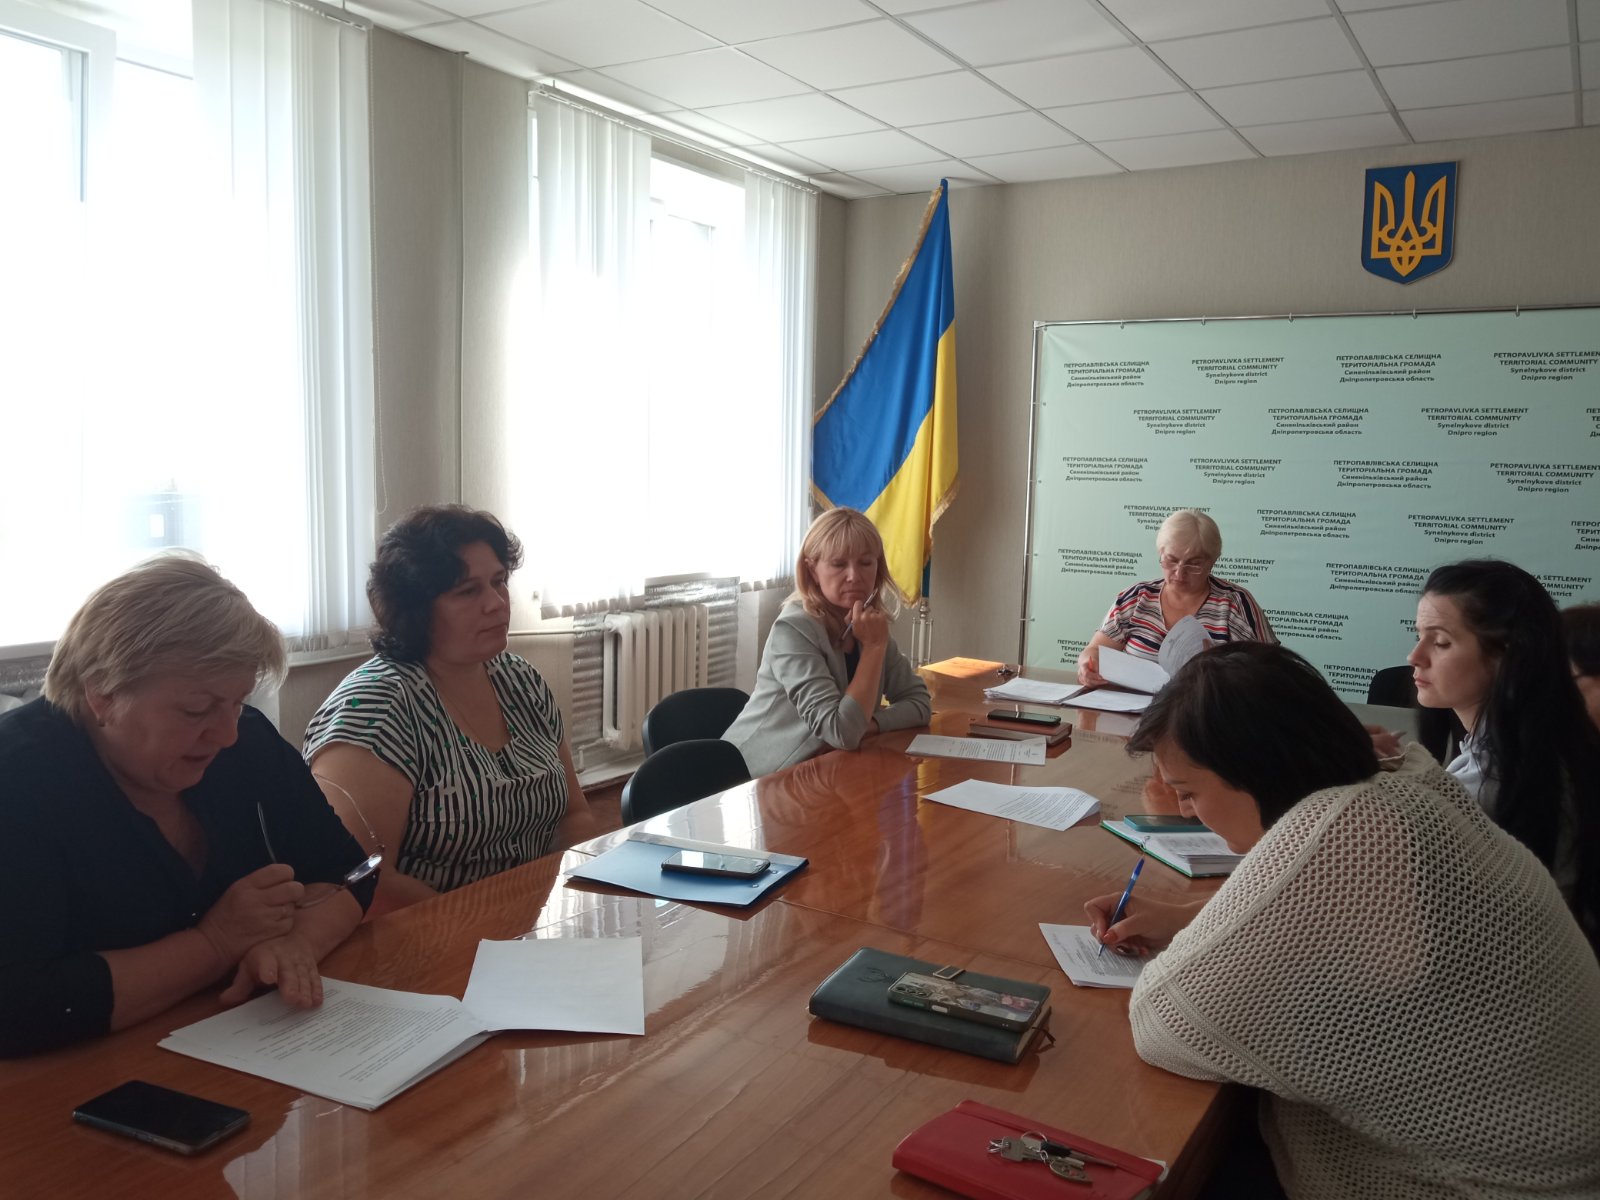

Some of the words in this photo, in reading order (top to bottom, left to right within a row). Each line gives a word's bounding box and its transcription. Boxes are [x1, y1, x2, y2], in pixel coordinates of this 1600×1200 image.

[1549, 358, 1599, 366] COMMUNITY
[1521, 374, 1547, 382] Dnipro
[1548, 374, 1573, 382] region
[1490, 462, 1551, 470] PETROPAVLIVKA
[1545, 471, 1594, 479] COMMUNITY
[1518, 485, 1543, 493] Dnipro
[1408, 514, 1466, 522] PETROPAVLIVKA
[1467, 516, 1515, 524] SETTLEMENT
[1434, 537, 1459, 545] Dnipro
[1460, 538, 1483, 546] region
[1543, 575, 1592, 583] SETTLEMENT
